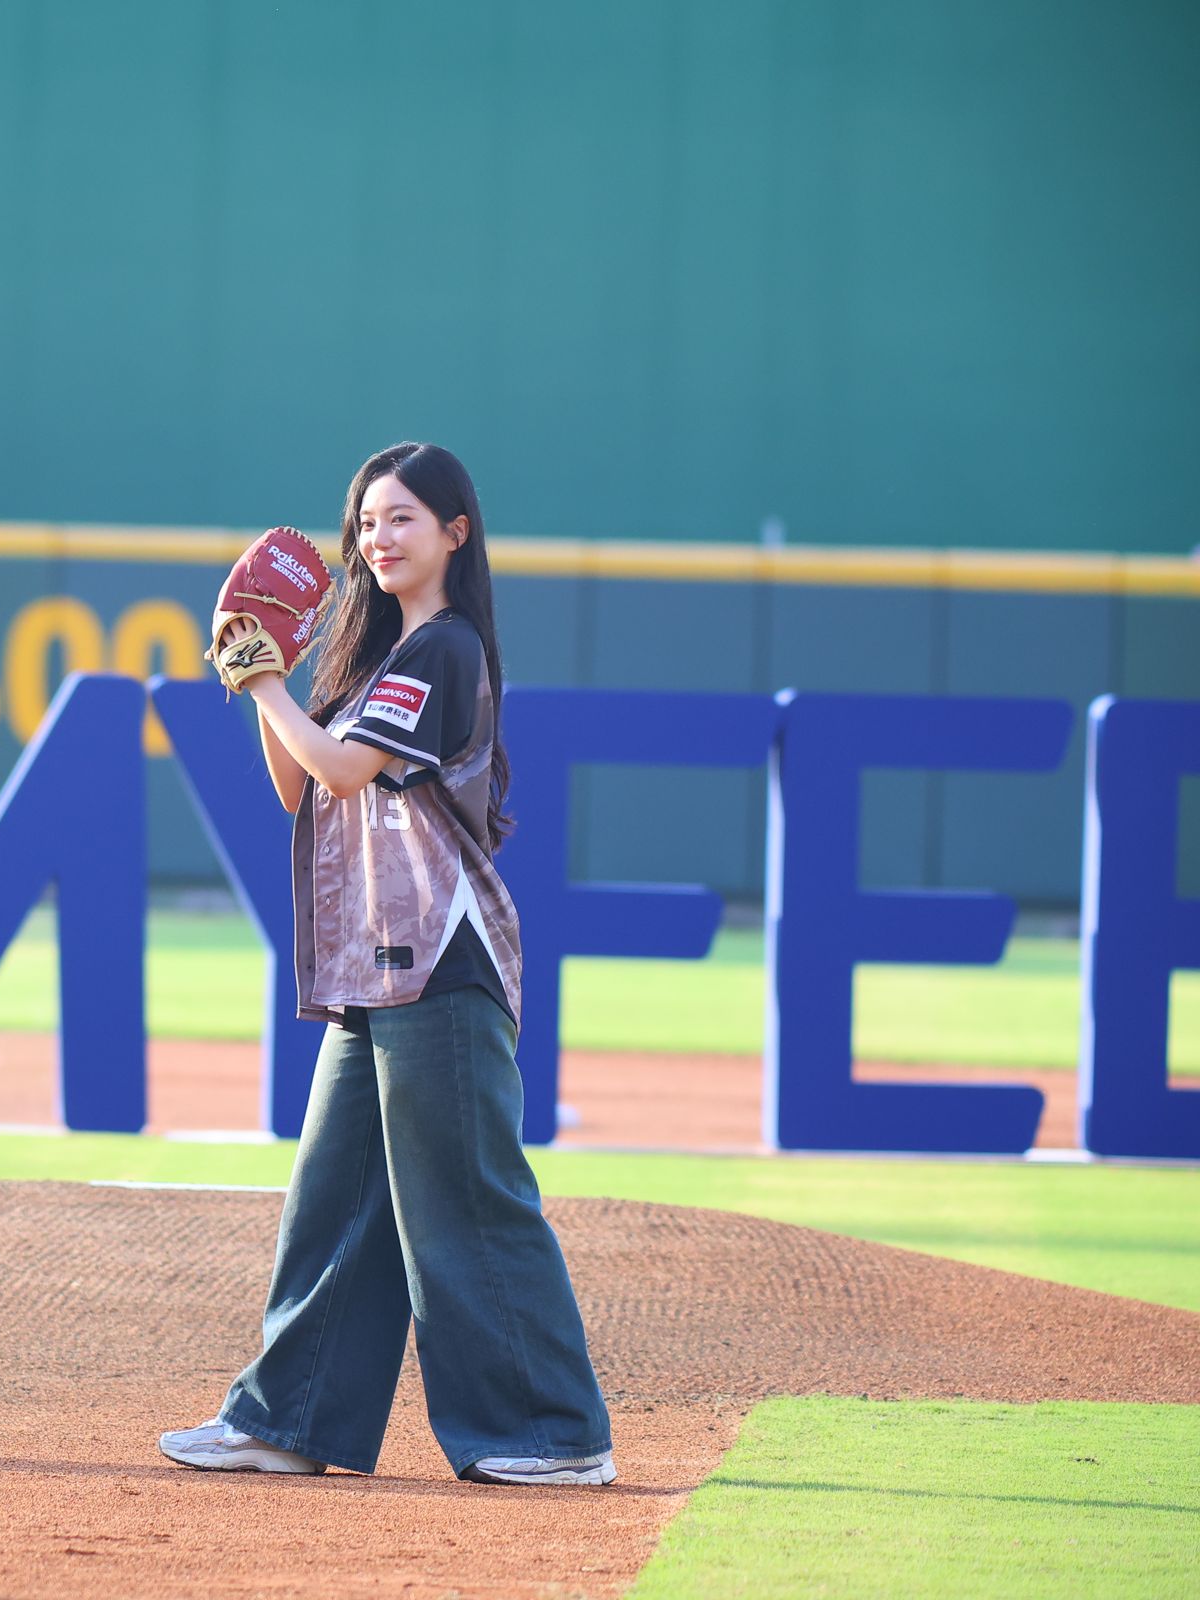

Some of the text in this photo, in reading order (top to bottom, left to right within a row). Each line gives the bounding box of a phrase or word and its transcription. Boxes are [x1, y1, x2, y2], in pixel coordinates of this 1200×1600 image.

[268, 545, 318, 592] Rakuten
[270, 561, 307, 592] MONKEYS
[292, 608, 317, 644] Rakuten
[371, 687, 417, 704] JOHNSON
